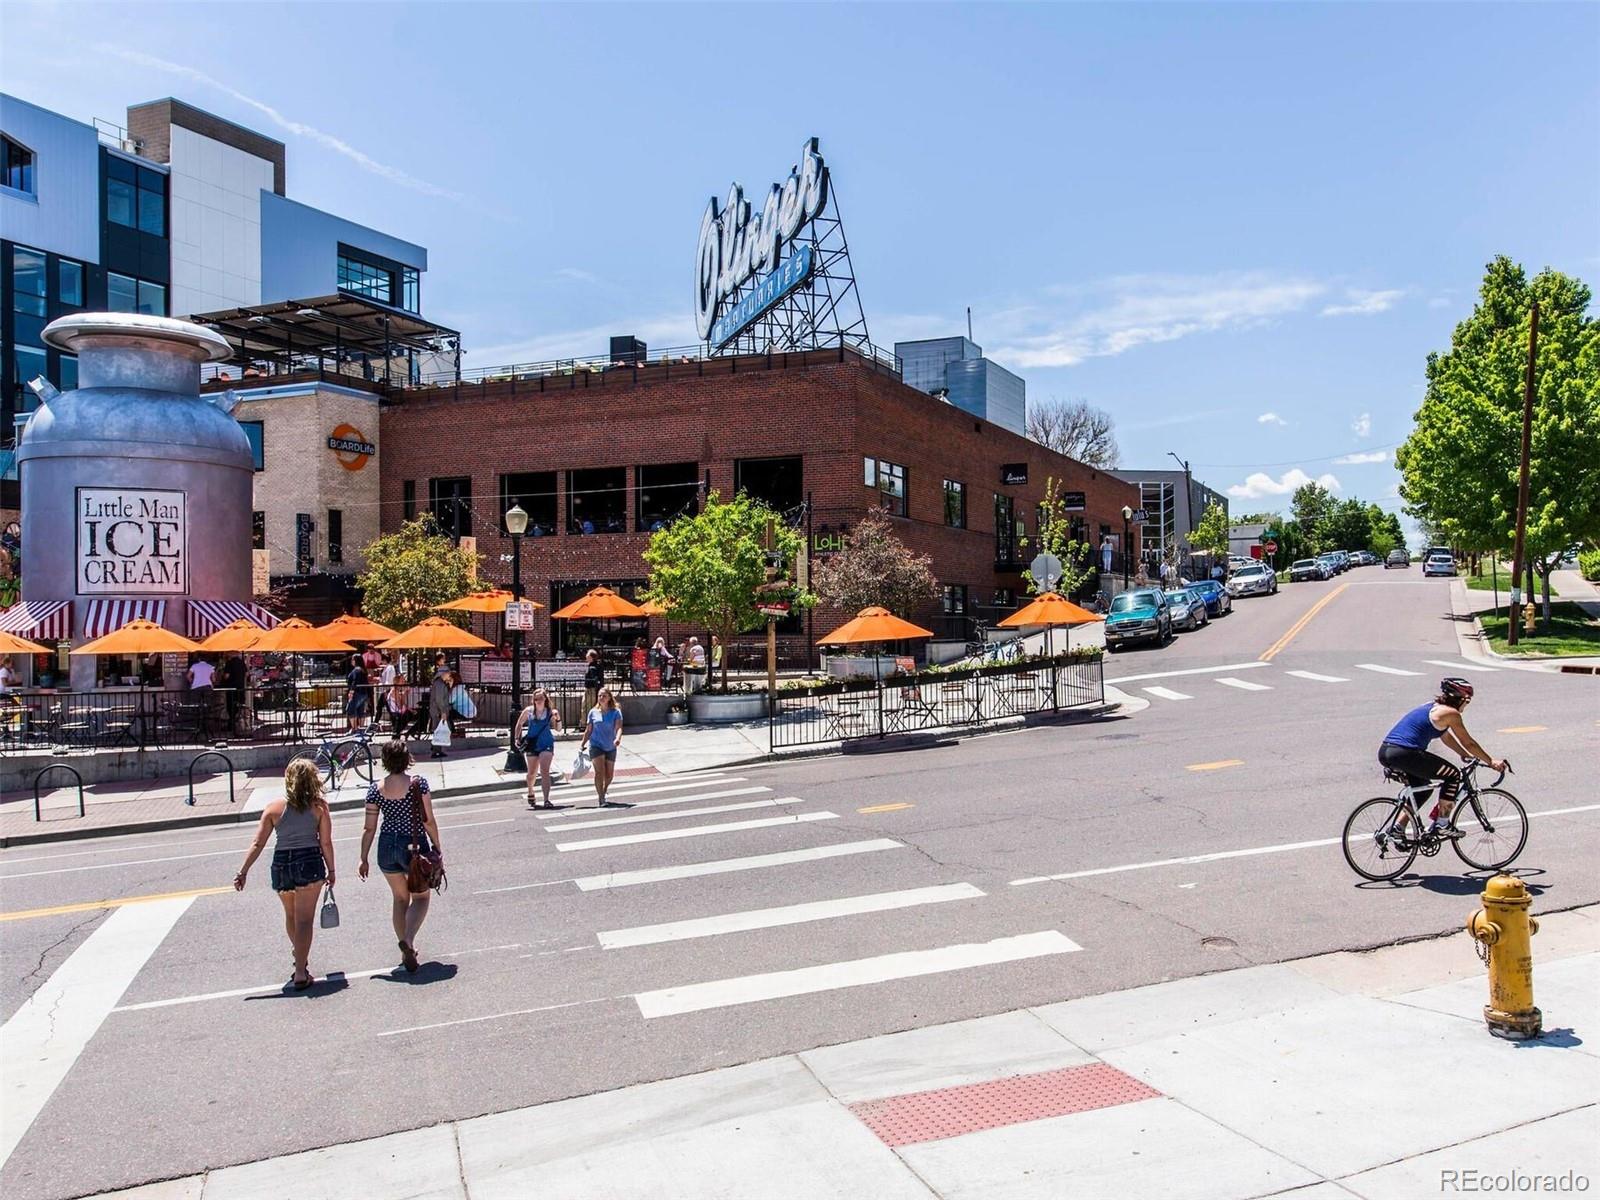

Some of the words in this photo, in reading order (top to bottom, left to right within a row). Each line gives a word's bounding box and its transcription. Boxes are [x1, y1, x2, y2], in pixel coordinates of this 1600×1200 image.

[84, 496, 133, 518] Little
[139, 498, 179, 519] Man
[84, 520, 180, 558] ICE
[84, 560, 181, 585] CREAM
